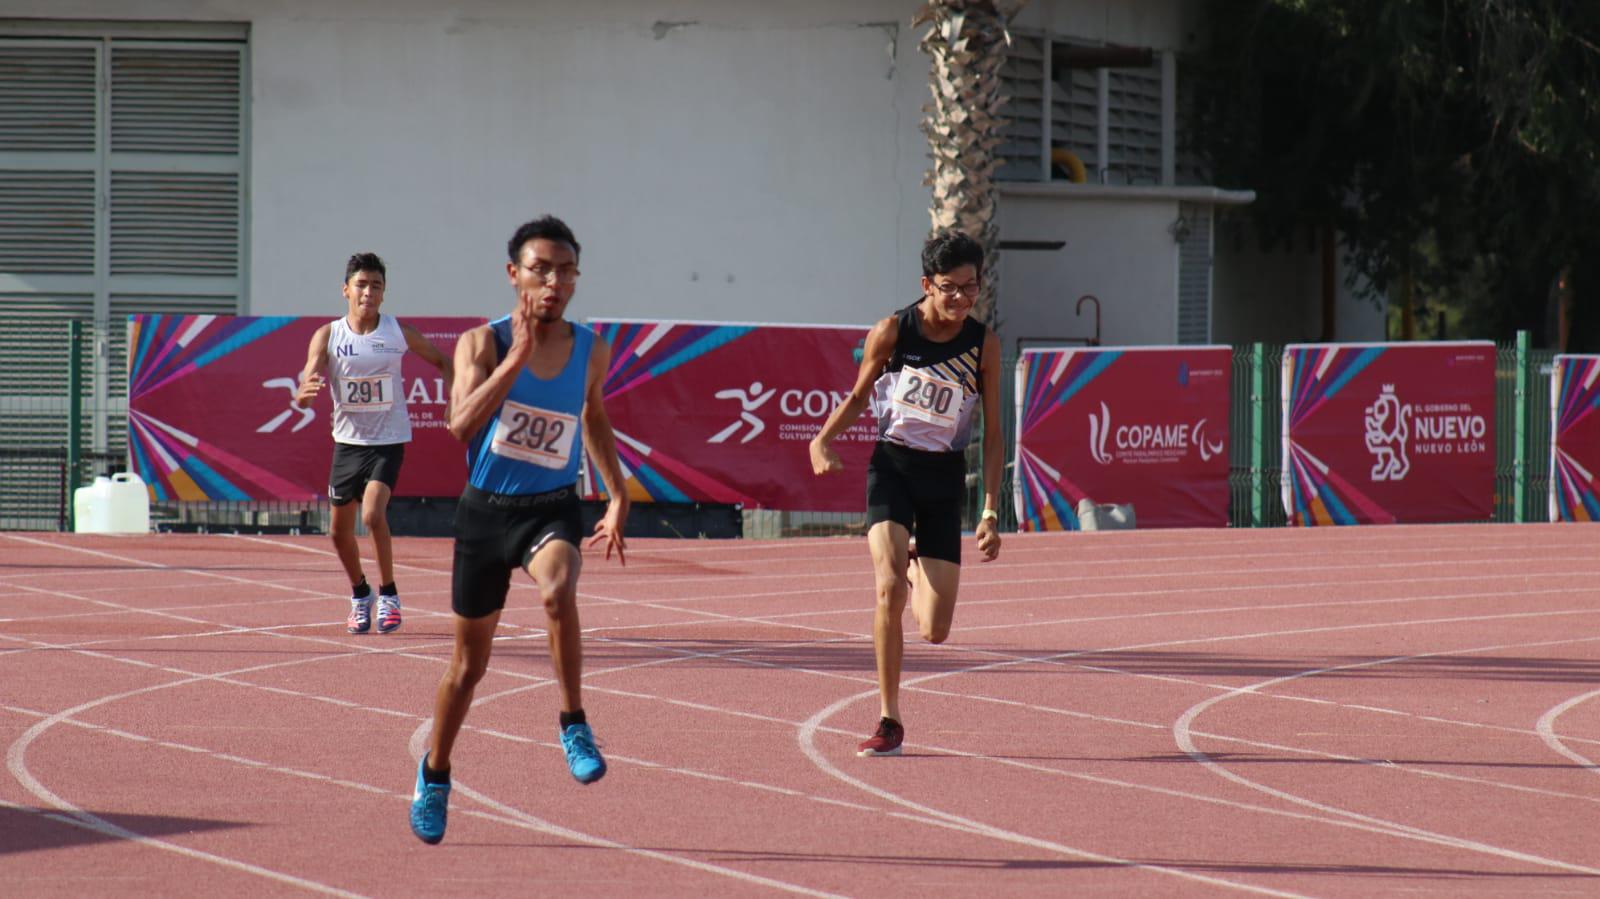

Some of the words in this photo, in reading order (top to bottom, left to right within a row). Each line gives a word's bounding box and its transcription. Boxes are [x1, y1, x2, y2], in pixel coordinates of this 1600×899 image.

[336, 344, 359, 357] NL
[347, 380, 384, 403] 291
[902, 376, 954, 414] 290
[505, 412, 565, 454] 292
[779, 423, 822, 432] COMISIÓN
[1116, 424, 1189, 448] COPAME
[1415, 415, 1486, 438] NUEVO
[1415, 440, 1452, 453] NUEVO
[1457, 438, 1486, 453] LEÓN
[487, 494, 531, 506] NIKE
[534, 488, 569, 504] PRO
